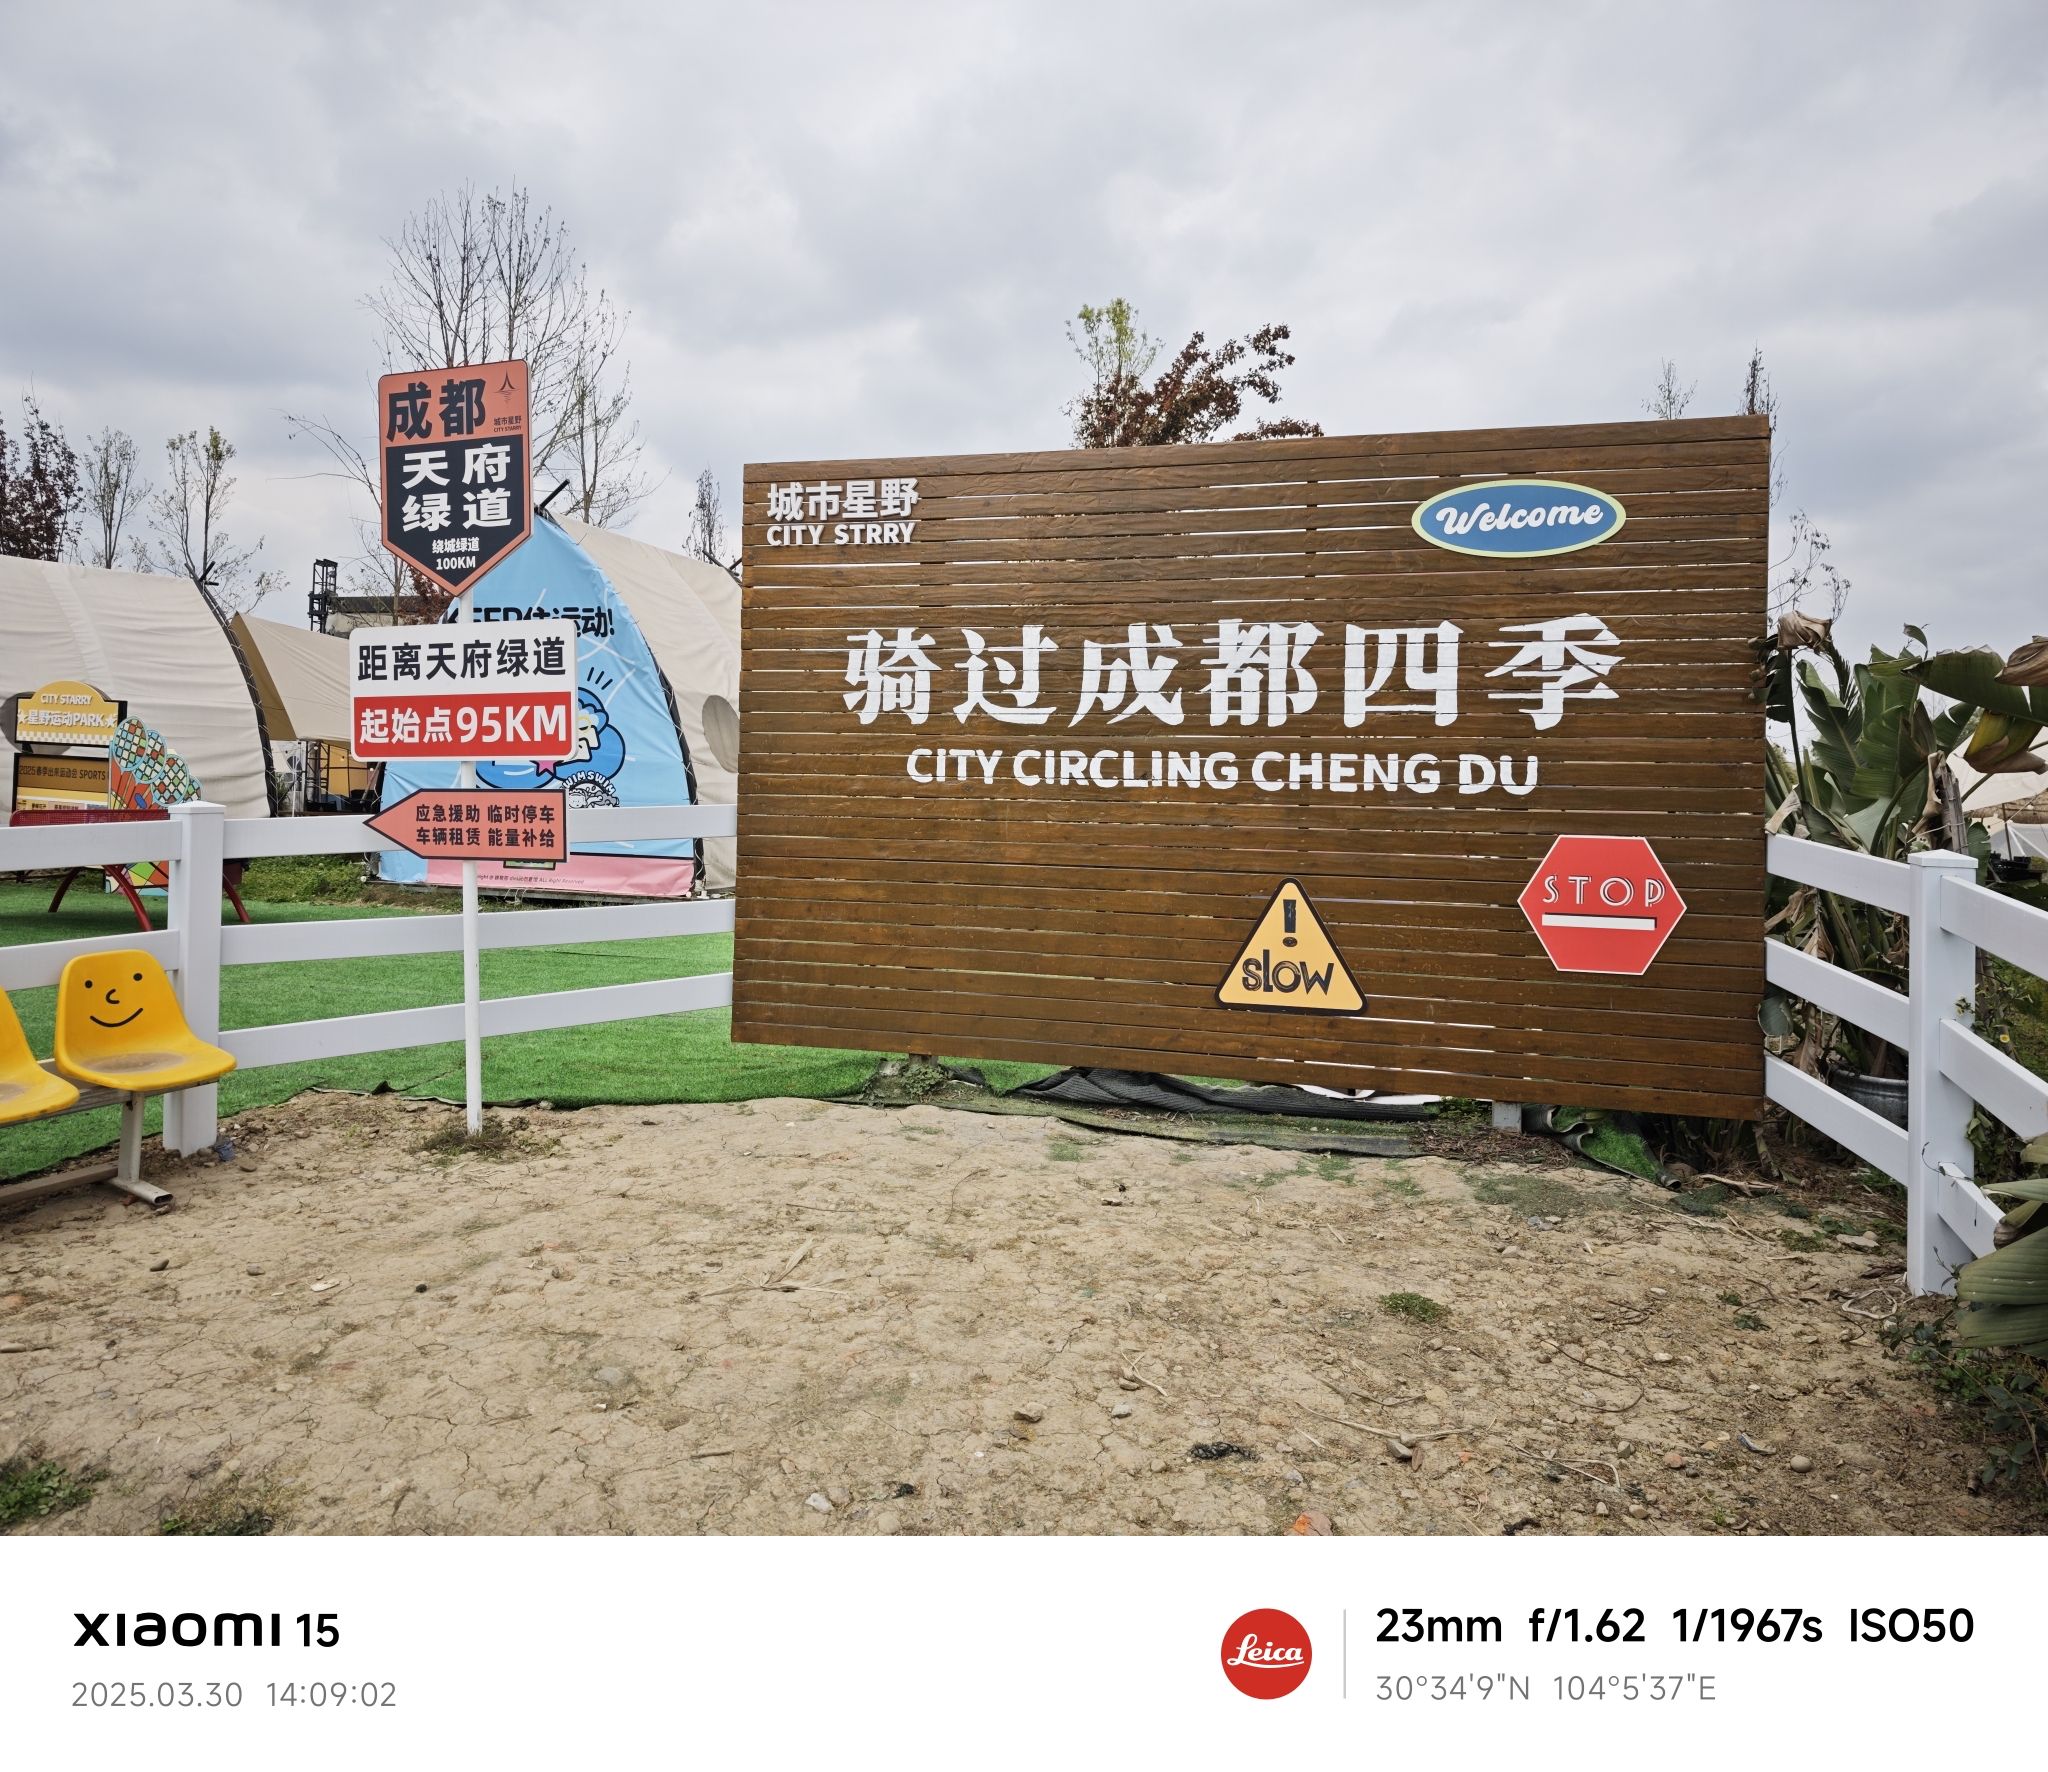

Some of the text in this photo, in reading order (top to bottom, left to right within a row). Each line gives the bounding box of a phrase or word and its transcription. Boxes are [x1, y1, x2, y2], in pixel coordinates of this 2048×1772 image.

[386, 378, 487, 442] 成都
[402, 443, 511, 489] 天府
[402, 488, 512, 532] 绿道
[767, 478, 919, 521] 城市星野
[766, 522, 916, 546] CITY STRRY
[1435, 503, 1604, 535] Welcome
[432, 536, 480, 554] 绕城绿道
[436, 556, 476, 570] 100KM
[357, 636, 567, 682] 距离天府绿道
[844, 611, 1626, 731] 骑过成都四季
[41, 693, 92, 705] CITY STARRY
[359, 704, 567, 745] 起始点95KM
[79, 769, 106, 781] SPORTS
[906, 748, 1538, 795] CITY CIRCLING CHENG DU
[416, 804, 555, 824] 应急援助 临时停车
[416, 827, 555, 848] 车辆租赁 能量补给
[1542, 873, 1666, 907] STOP
